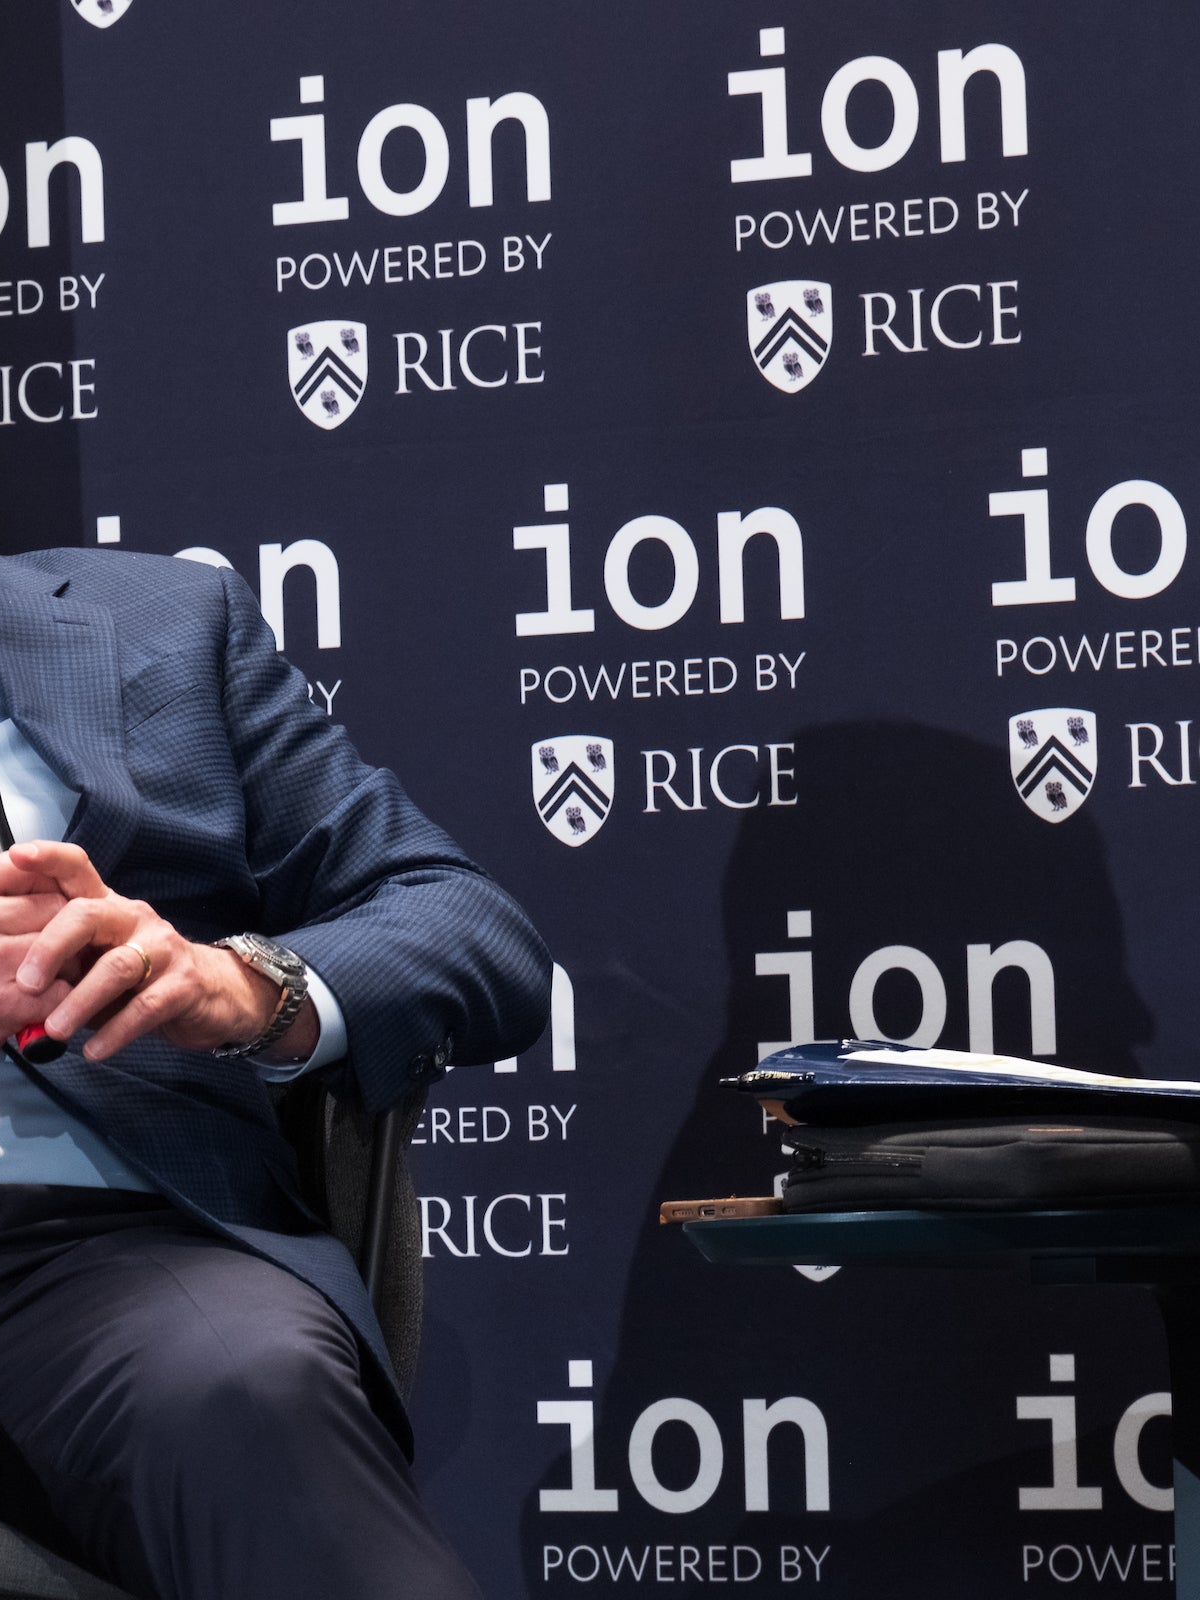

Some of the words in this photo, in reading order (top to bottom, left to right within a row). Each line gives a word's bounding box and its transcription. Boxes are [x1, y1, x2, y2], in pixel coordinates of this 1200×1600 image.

[728, 27, 1028, 183] ion
[270, 75, 551, 226] ion
[736, 197, 958, 251] POWERED
[978, 189, 1028, 229] BY
[60, 273, 105, 311] BY
[277, 240, 486, 292] POWERED
[504, 233, 552, 272] BY
[860, 280, 1021, 356] RICE
[394, 322, 544, 394] RICE
[513, 484, 805, 636] ion
[989, 448, 1187, 606] io
[521, 657, 737, 704] POWERED
[756, 652, 805, 690] BY
[996, 627, 1200, 677] POWERE
[641, 743, 797, 812] RICE
[755, 910, 1057, 1065] ion
[528, 1104, 576, 1141] BY
[417, 1194, 568, 1257] RICE
[537, 1360, 829, 1513] ion
[1017, 1354, 1174, 1511] io
[544, 1545, 761, 1582] POWERED
[781, 1546, 830, 1581] BY
[1023, 1545, 1176, 1582] POWE
